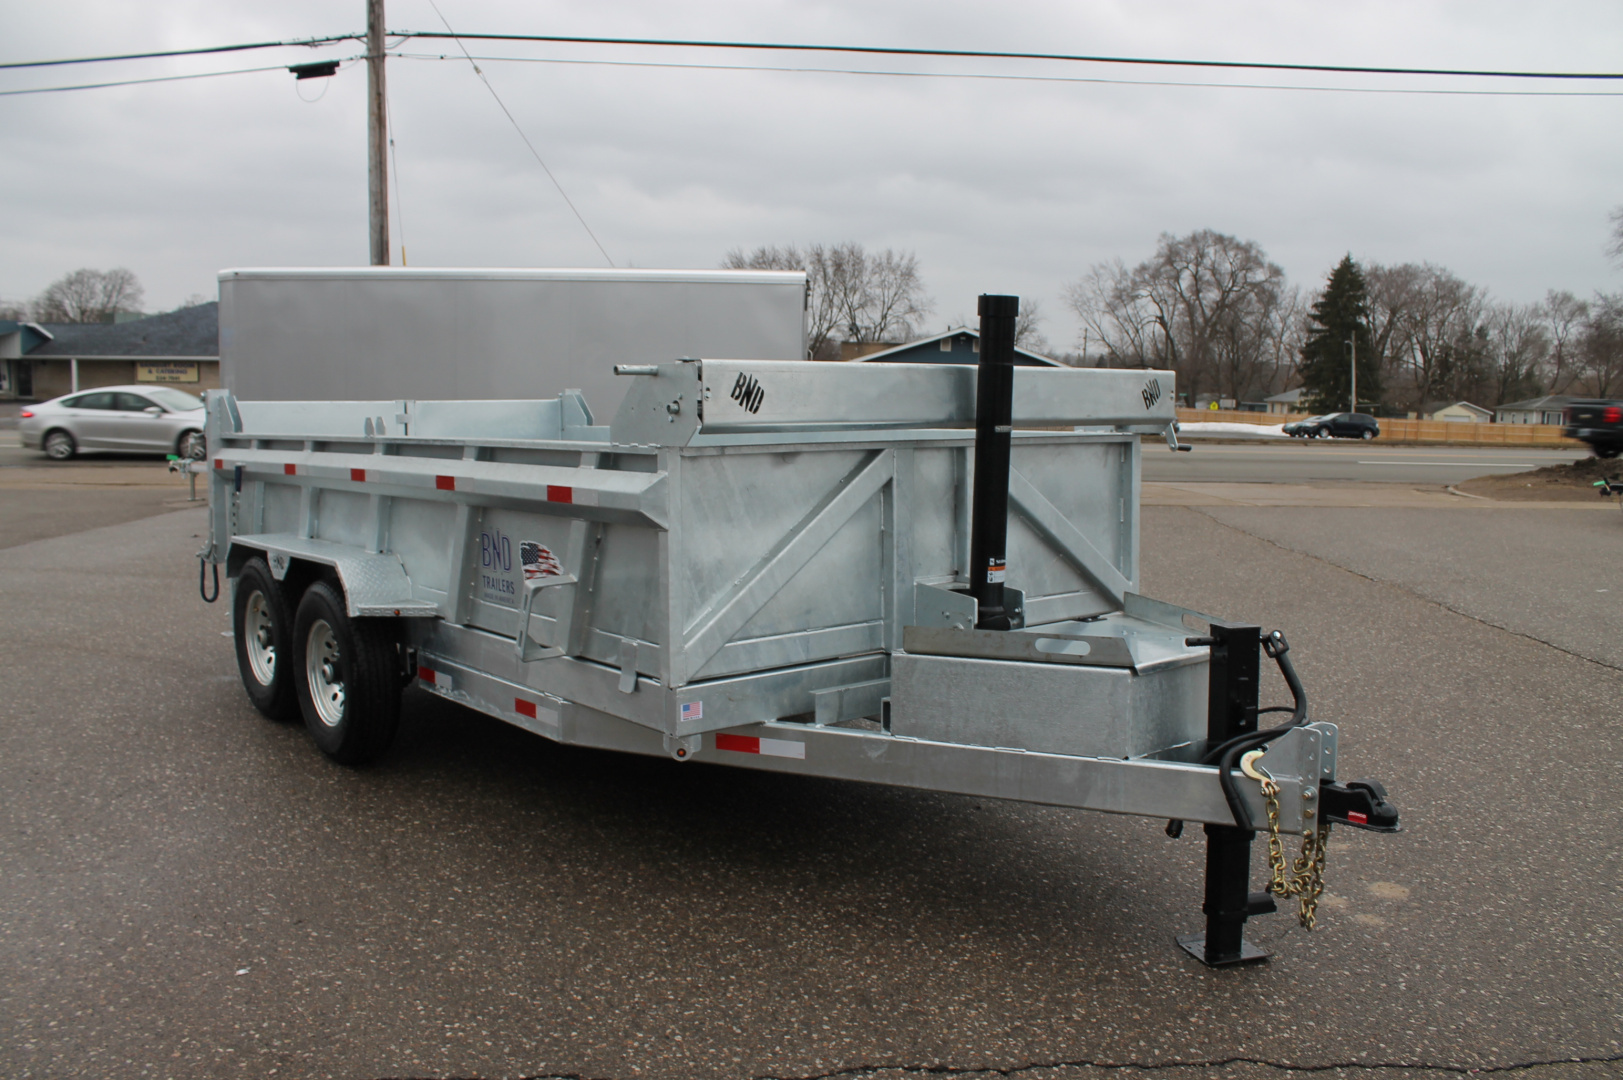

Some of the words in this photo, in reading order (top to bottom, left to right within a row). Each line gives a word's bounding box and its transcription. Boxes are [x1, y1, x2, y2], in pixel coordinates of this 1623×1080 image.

[730, 371, 765, 415] BND
[481, 529, 512, 572] BND
[482, 575, 515, 595] TRAILERS
